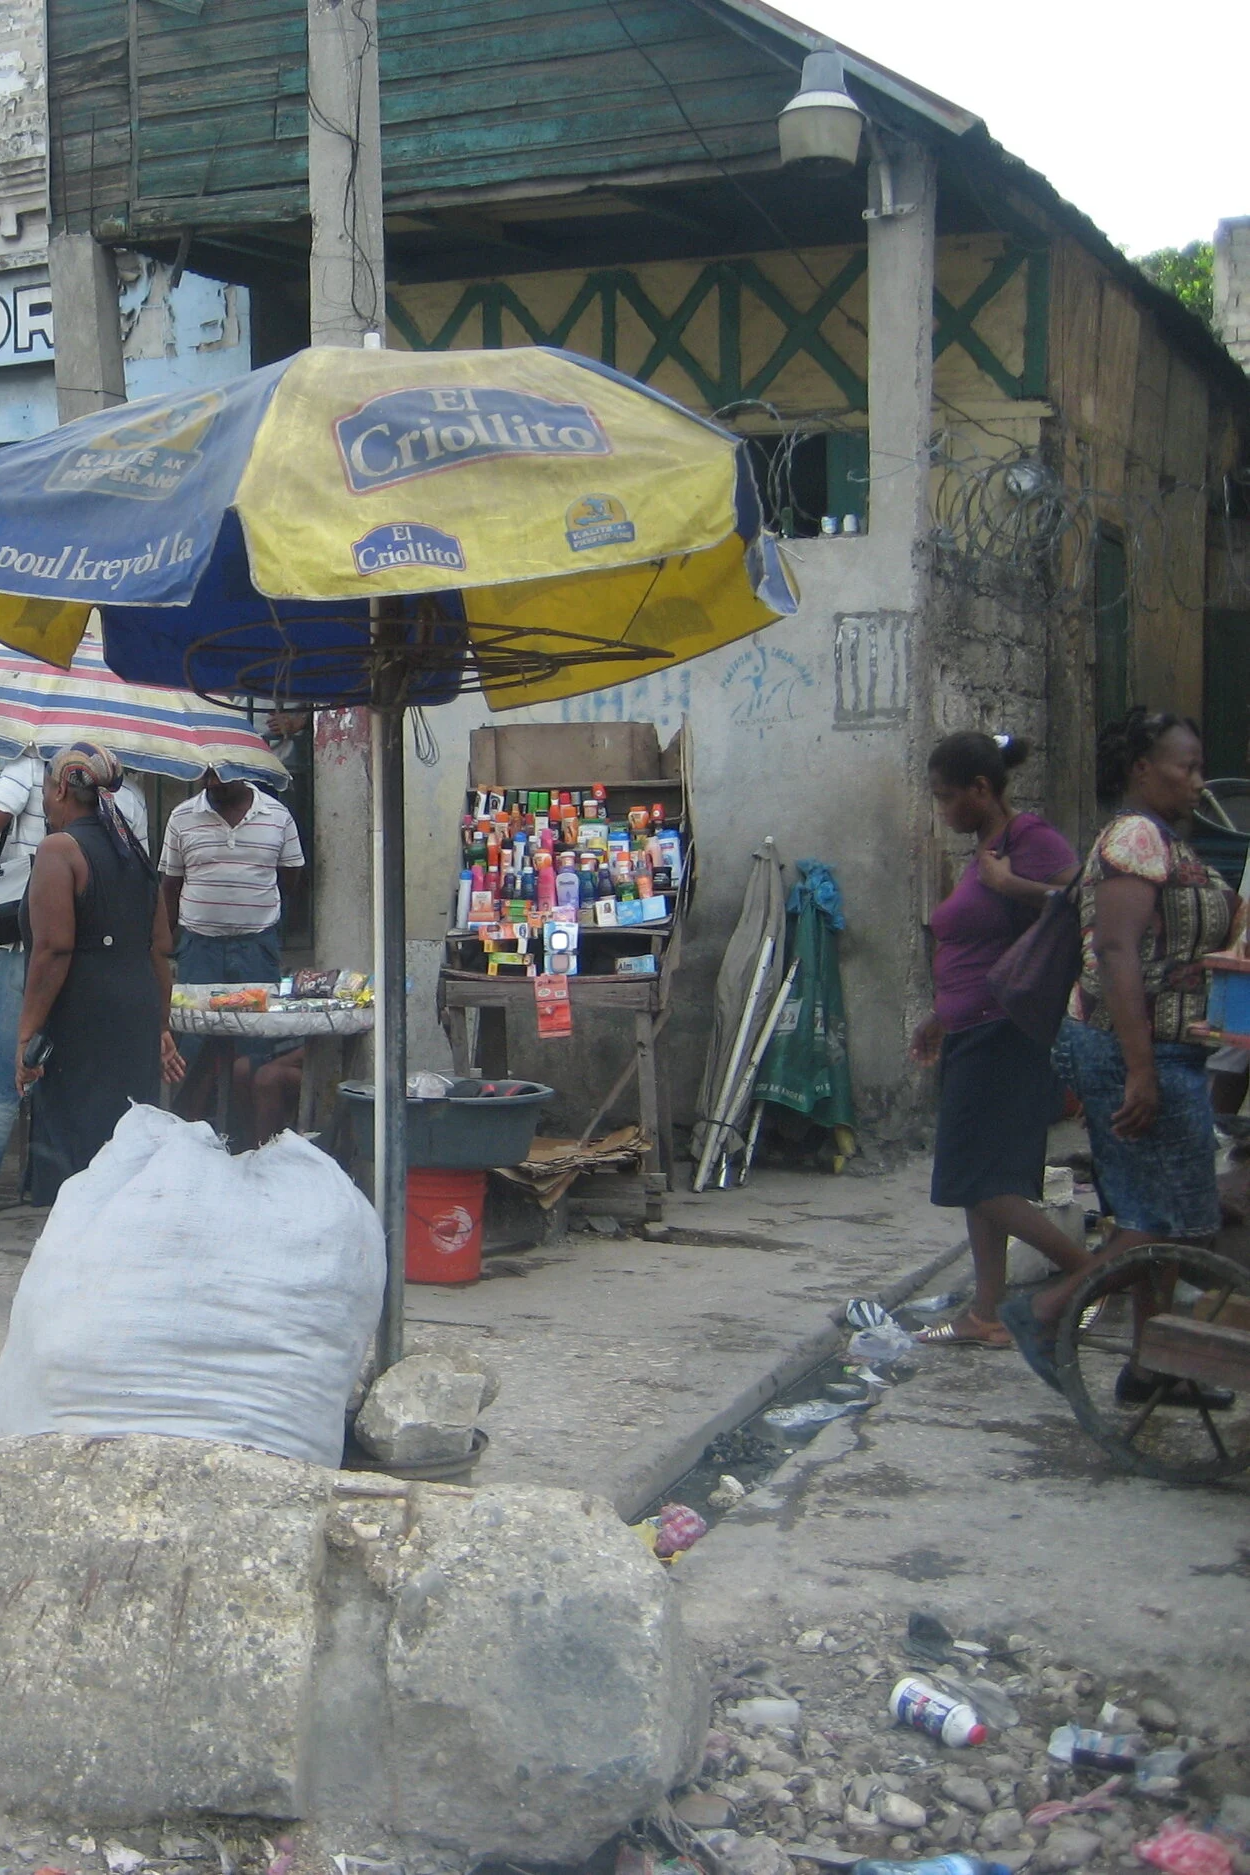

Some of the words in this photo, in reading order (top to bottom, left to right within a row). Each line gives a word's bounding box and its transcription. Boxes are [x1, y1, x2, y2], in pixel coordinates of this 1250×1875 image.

[428, 389, 480, 412] El
[350, 413, 596, 478] Criollito
[391, 526, 414, 541] El
[66, 536, 170, 591] kreyòl
[167, 530, 195, 566] la
[358, 542, 460, 570] Criollito
